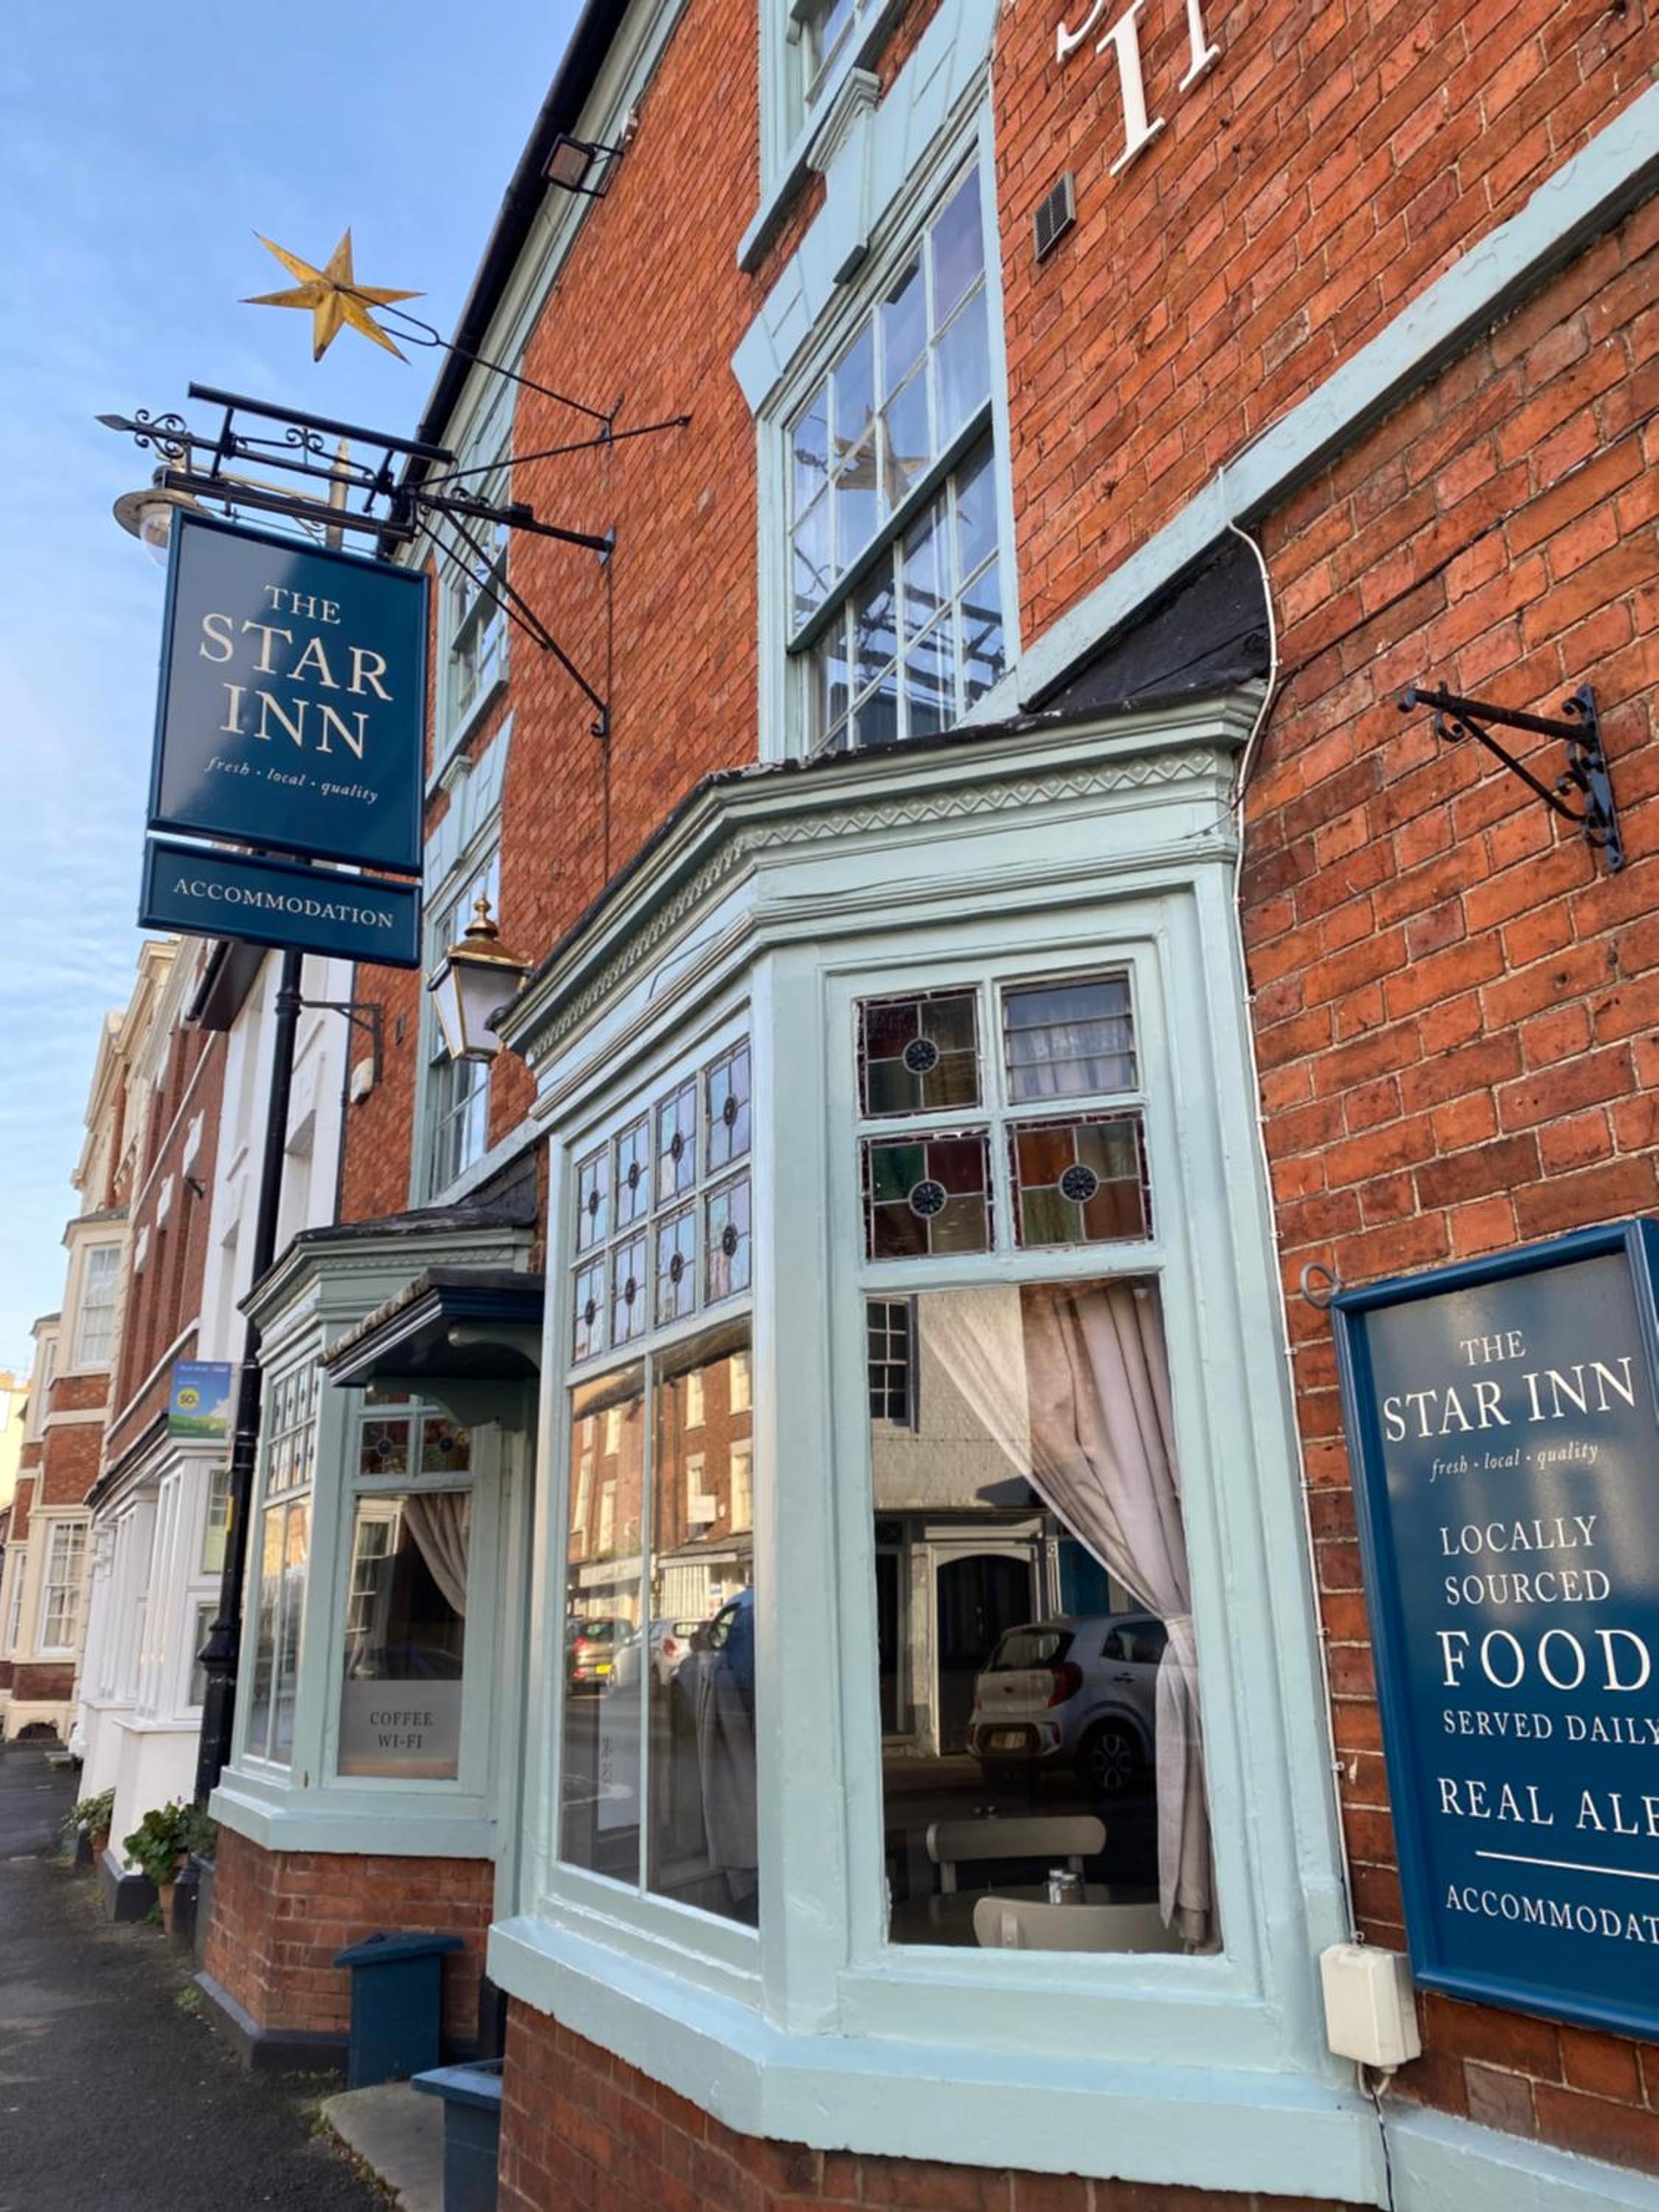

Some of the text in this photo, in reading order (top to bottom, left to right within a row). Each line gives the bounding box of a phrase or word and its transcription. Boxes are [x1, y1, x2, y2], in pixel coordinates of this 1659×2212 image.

[264, 585, 341, 625] THE
[200, 613, 394, 702] STAR
[220, 683, 369, 760] INN
[204, 756, 378, 805] fresh local quality
[173, 878, 394, 928] ACCOMMODATION
[1460, 1330, 1526, 1366] THE
[1383, 1357, 1635, 1441] STAR INN
[1429, 1441, 1599, 1483] fresh local quality
[1440, 1515, 1596, 1556] LOCALLY
[1445, 1570, 1610, 1605] SOURCED
[1436, 1630, 1651, 1691] FOOD
[369, 1711, 434, 1727] COFFEE
[1444, 1710, 1659, 1745] SERVED DAILY
[378, 1733, 422, 1749] WI-FI
[1438, 1777, 1659, 1837] REAL ALE
